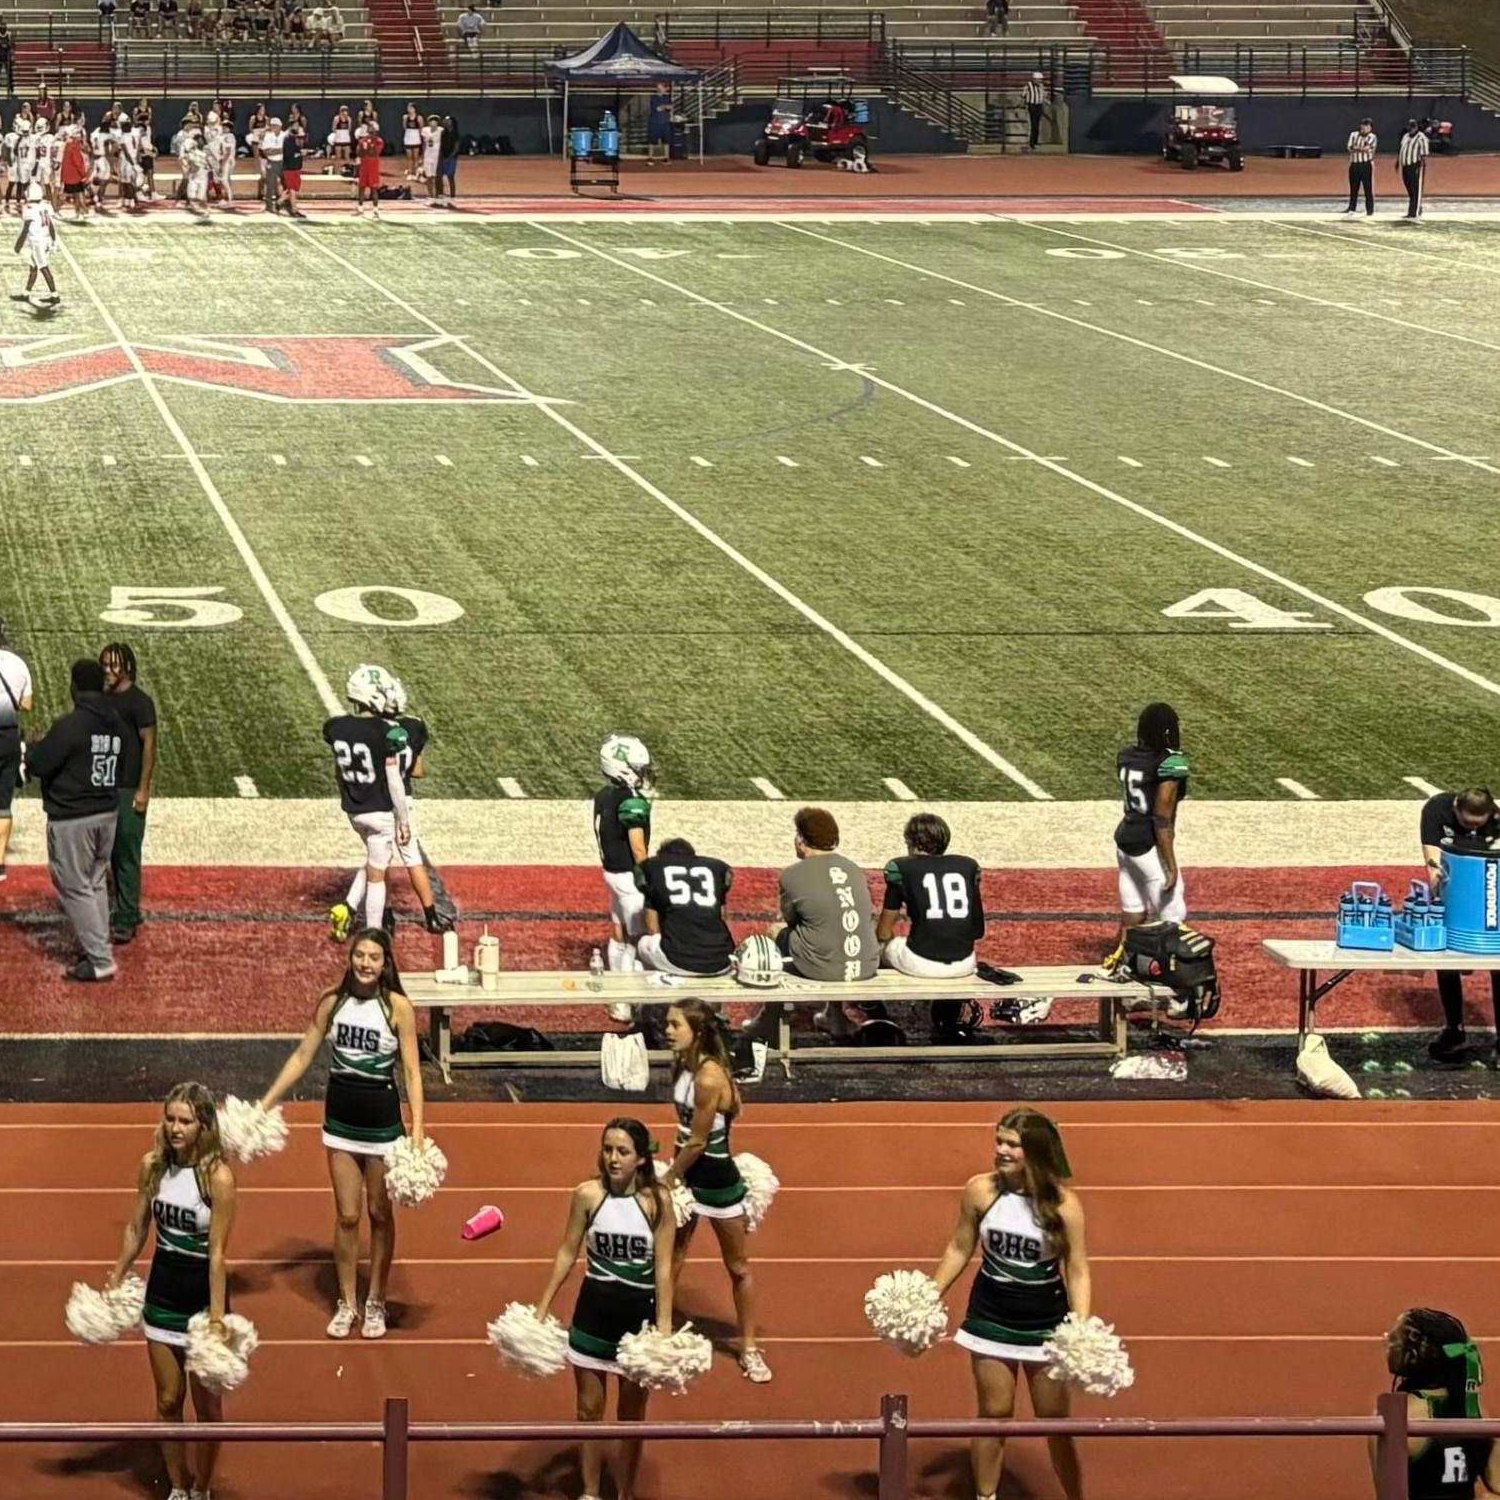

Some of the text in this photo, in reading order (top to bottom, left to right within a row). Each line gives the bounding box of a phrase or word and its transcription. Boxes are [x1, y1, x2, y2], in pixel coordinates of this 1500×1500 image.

[91, 755, 118, 787] 51
[334, 740, 377, 784] 23
[663, 865, 716, 907] 53
[922, 872, 969, 919] 18
[335, 1022, 381, 1051] RHS
[595, 1231, 648, 1260] RHS
[987, 1229, 1041, 1262] RHS
[1441, 1446, 1469, 1483] R
